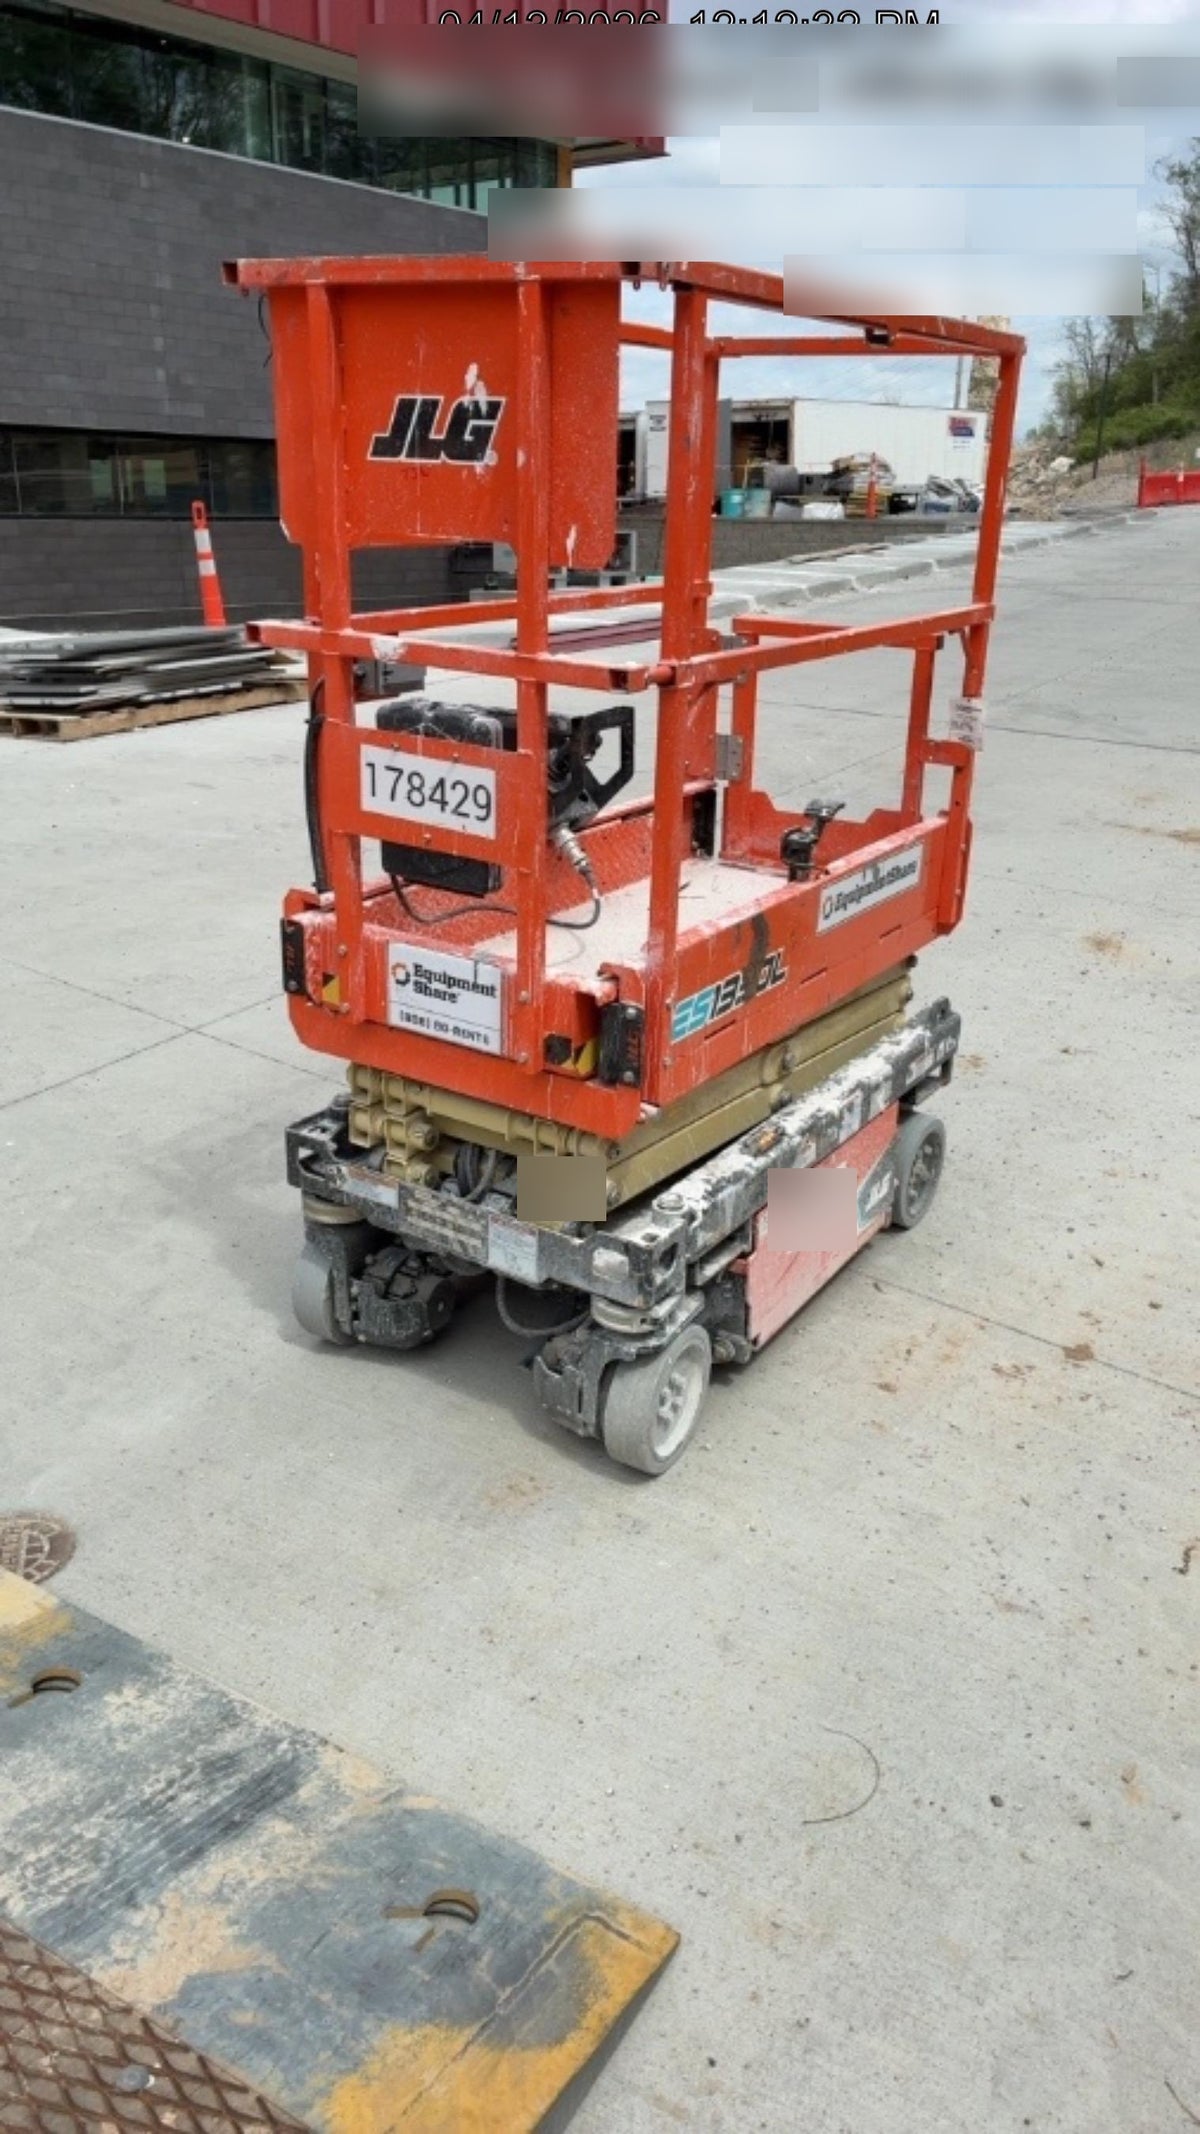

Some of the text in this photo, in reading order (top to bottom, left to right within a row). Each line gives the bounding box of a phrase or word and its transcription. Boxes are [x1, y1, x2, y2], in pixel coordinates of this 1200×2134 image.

[367, 395, 506, 465] JLG
[365, 762, 492, 822] 178429
[412, 962, 497, 999] Equipment
[412, 979, 459, 1004] Share
[671, 949, 787, 1043] ES130L
